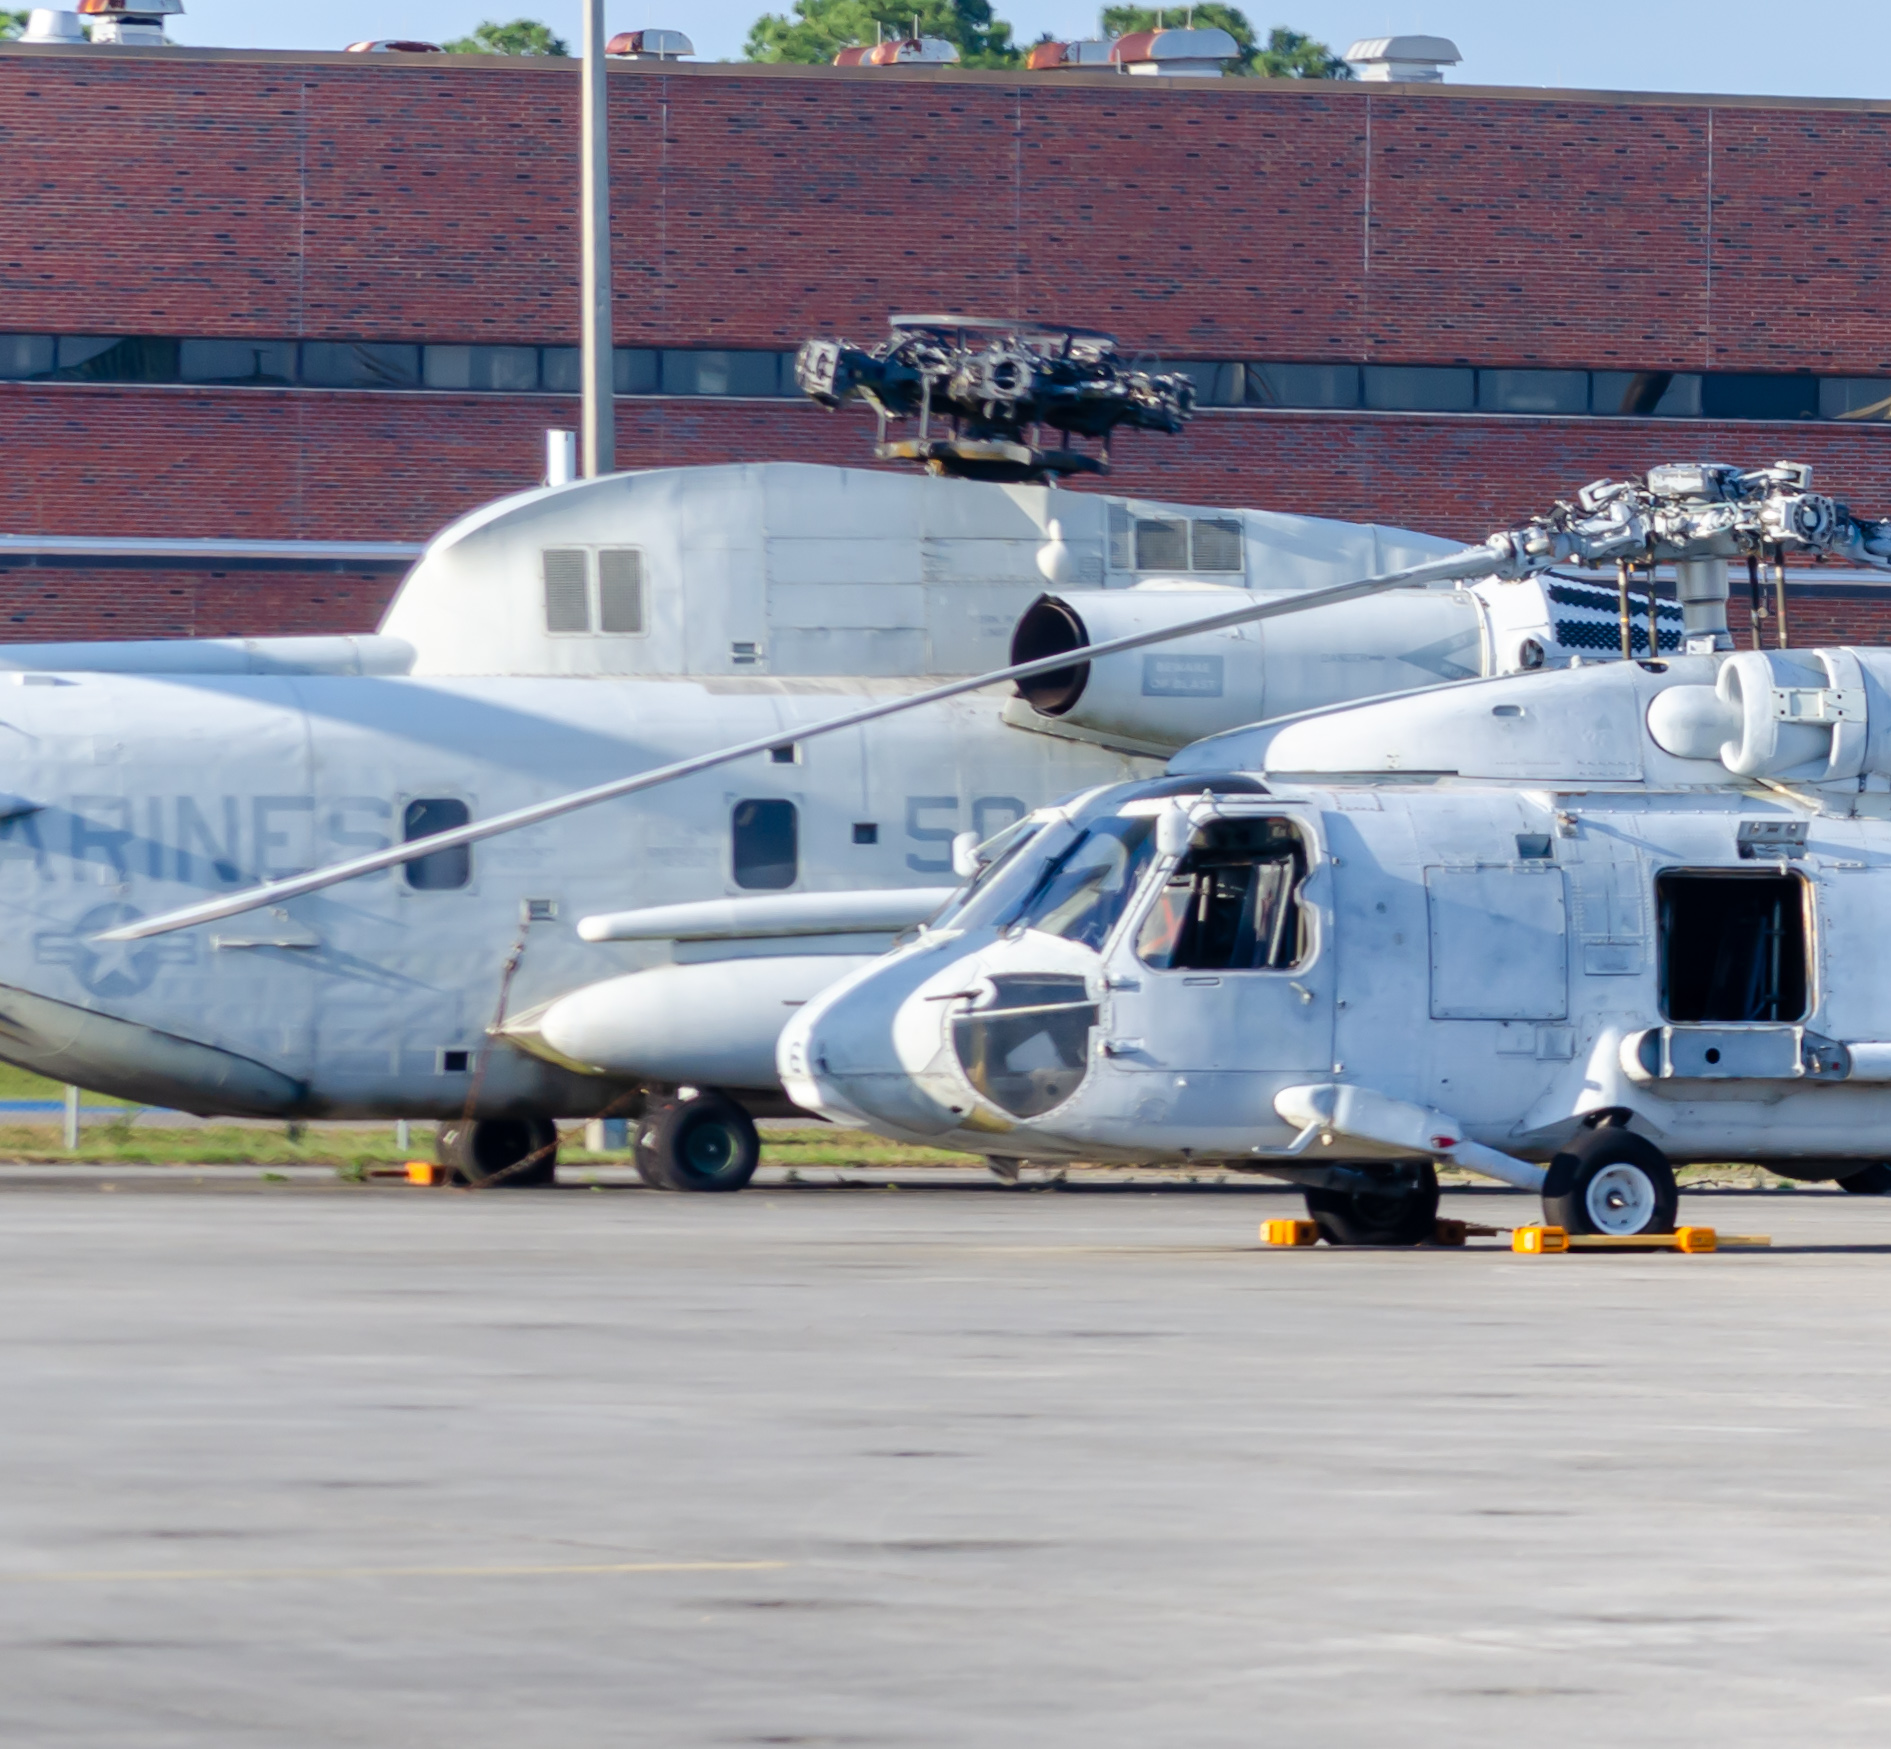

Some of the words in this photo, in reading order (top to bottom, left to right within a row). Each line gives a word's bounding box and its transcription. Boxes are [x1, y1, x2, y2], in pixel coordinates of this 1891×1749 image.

[1155, 661, 1210, 673] BEWARE
[1151, 679, 1169, 689] OF
[1171, 679, 1217, 690] BLAST
